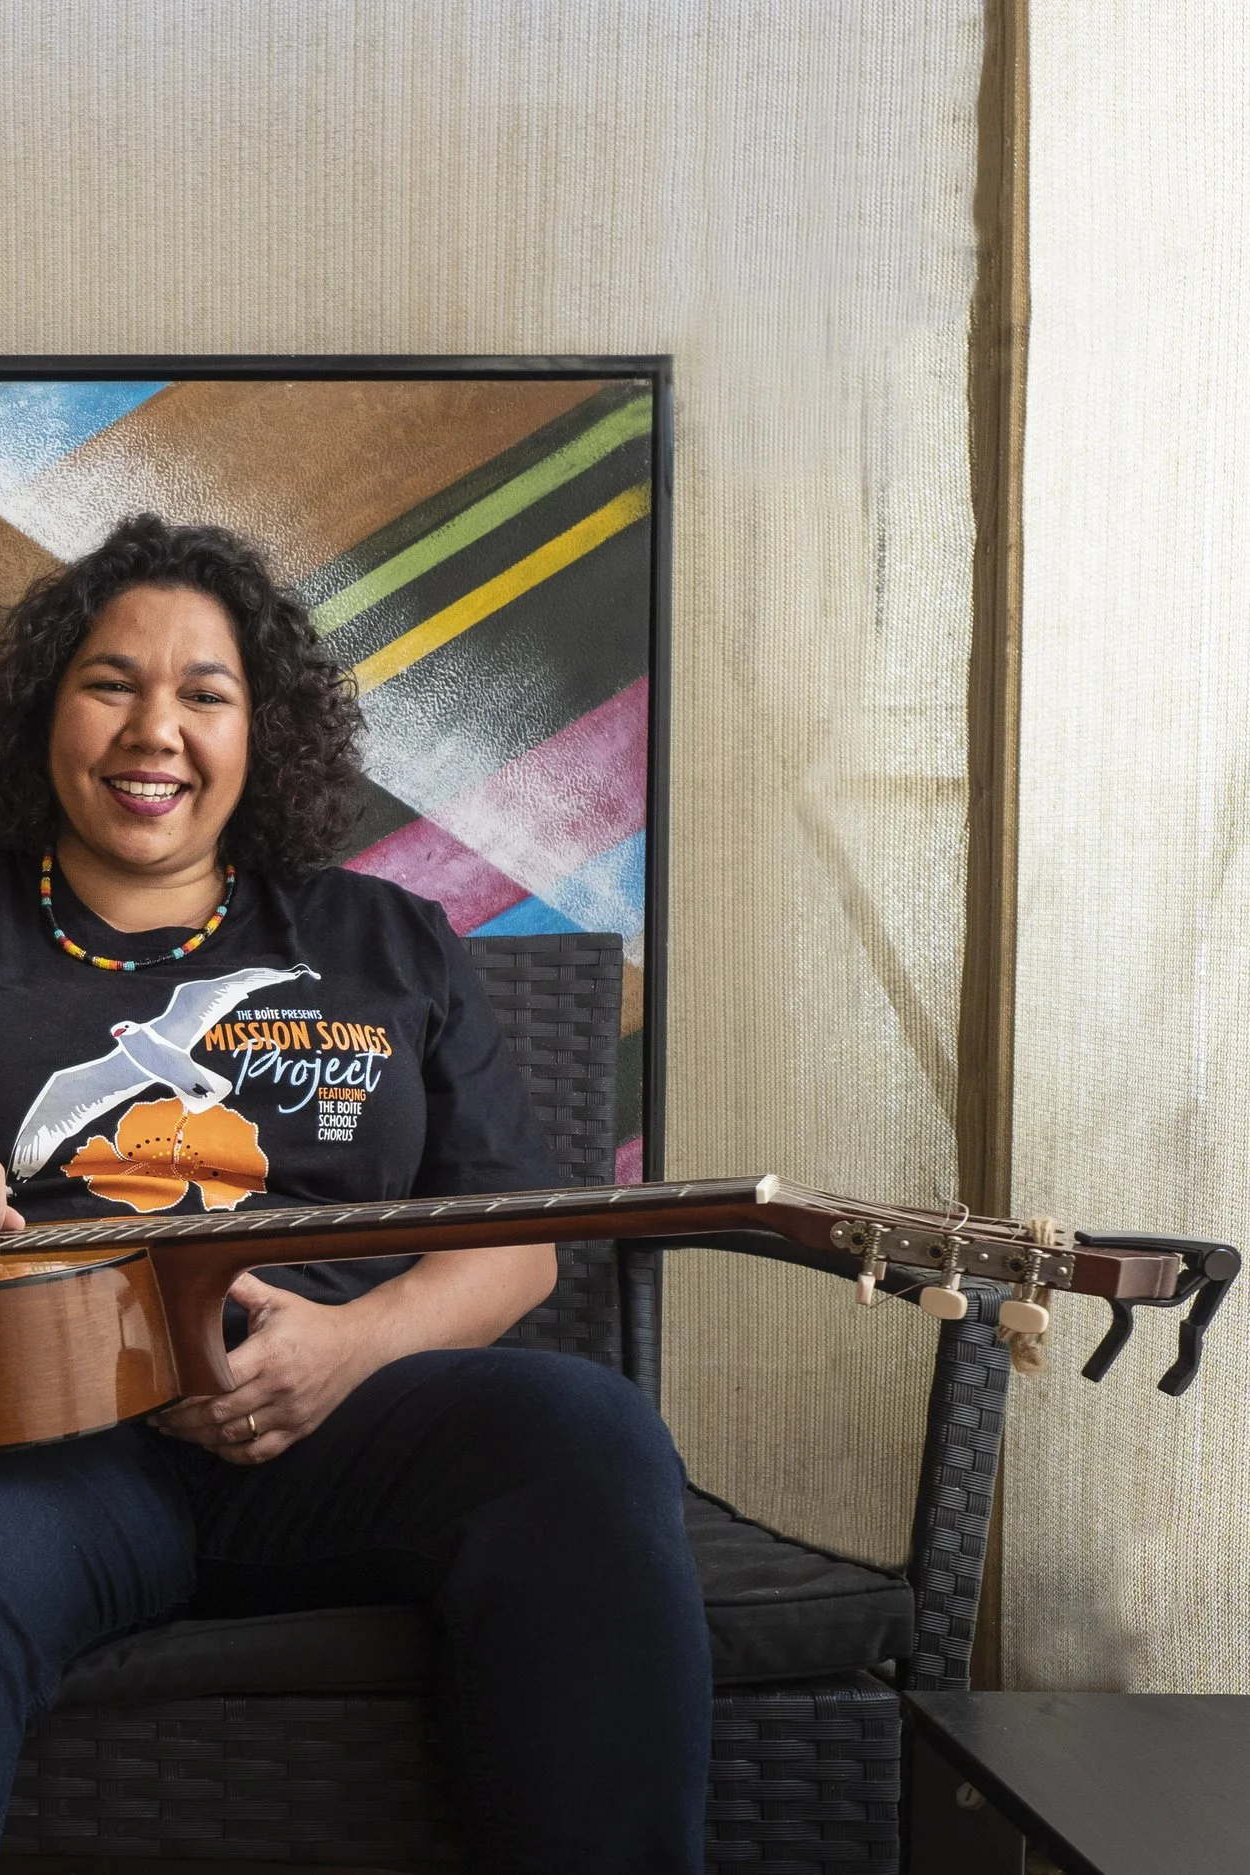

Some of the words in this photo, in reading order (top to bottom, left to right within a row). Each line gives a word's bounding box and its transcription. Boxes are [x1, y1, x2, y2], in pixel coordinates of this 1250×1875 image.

[236, 1010, 253, 1020] THE
[281, 1009, 323, 1020] PRESENTS
[204, 1021, 311, 1051] MISSION
[316, 1020, 393, 1057] SONGS
[232, 1037, 389, 1114] Project
[318, 1087, 367, 1102] FEATURING
[318, 1100, 336, 1114] THE
[318, 1114, 358, 1128] SCHOOLS
[318, 1128, 354, 1141] CHORUS
